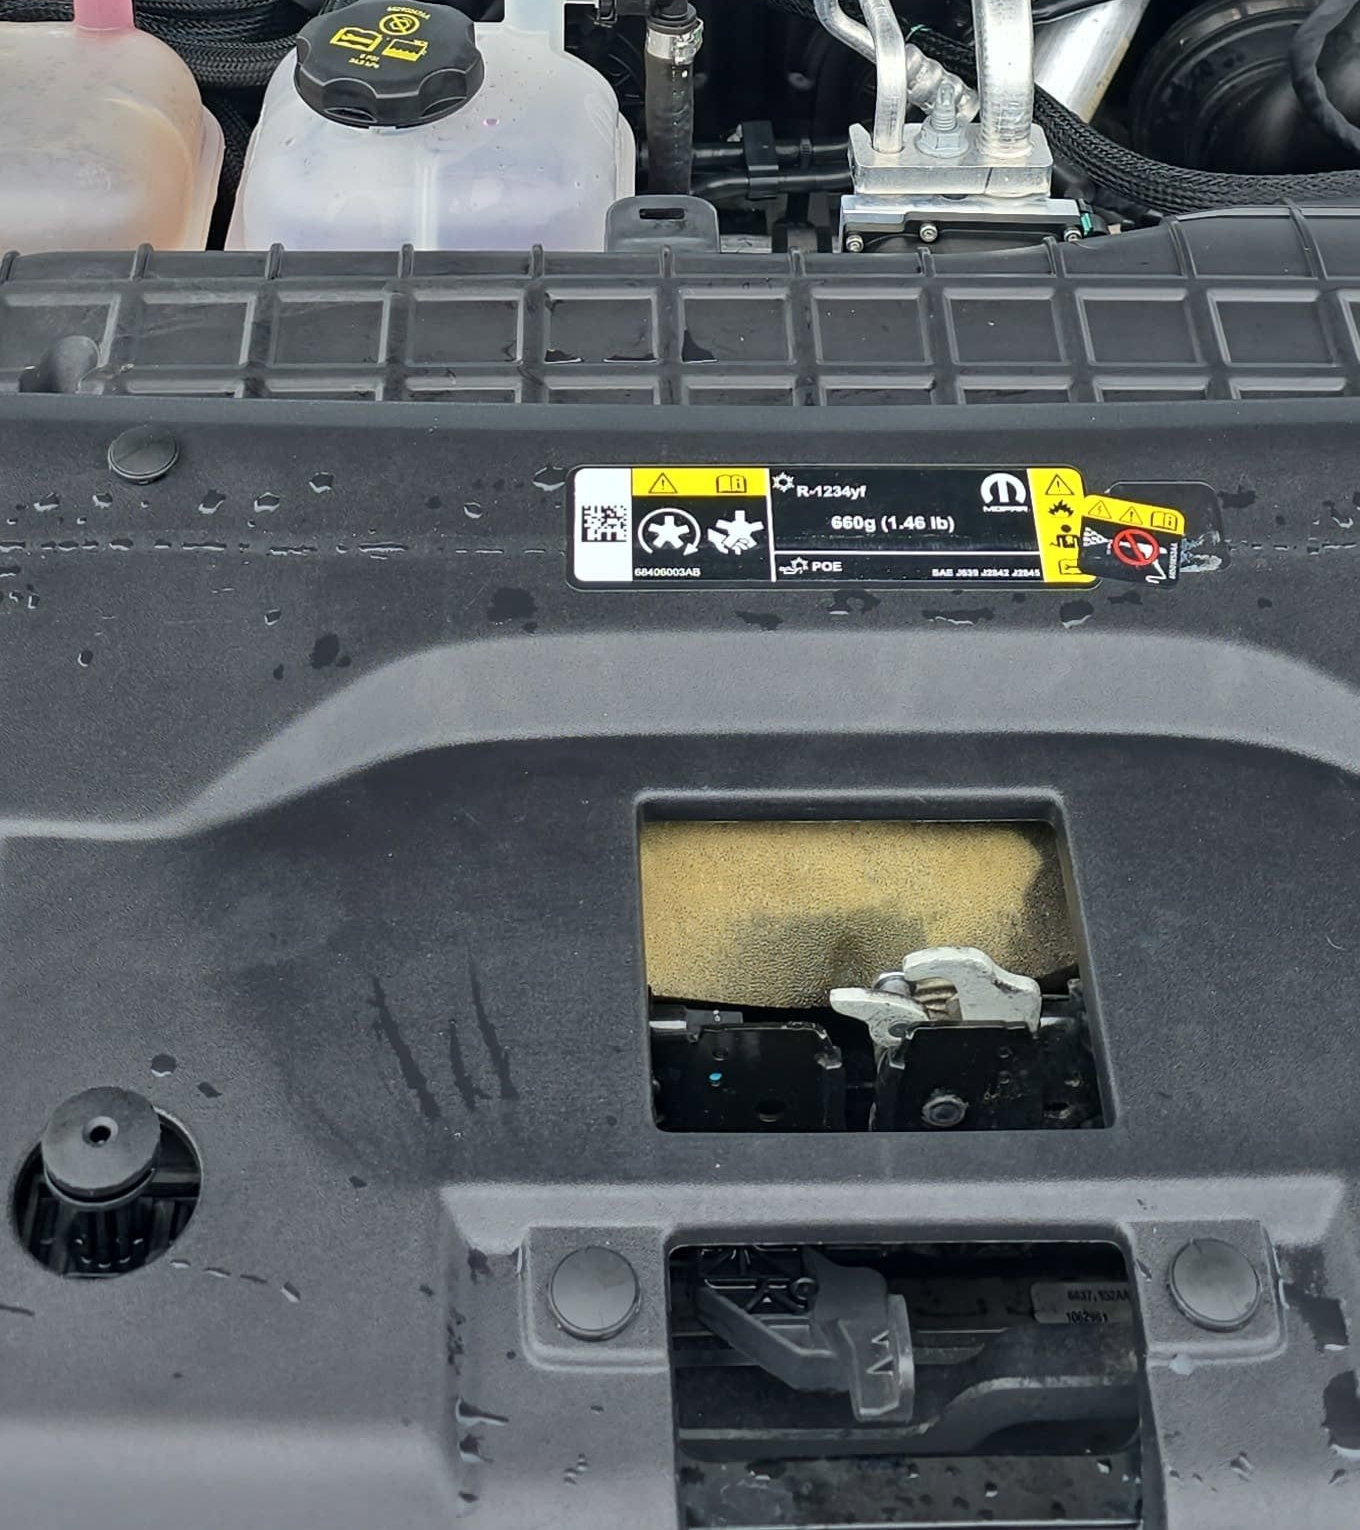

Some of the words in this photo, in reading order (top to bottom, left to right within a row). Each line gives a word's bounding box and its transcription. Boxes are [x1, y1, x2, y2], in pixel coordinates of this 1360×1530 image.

[796, 484, 867, 500] R-1234yf
[830, 515, 877, 532] 660g
[881, 515, 926, 533] (1.46
[930, 515, 956, 533] lb)
[811, 561, 843, 572] POE
